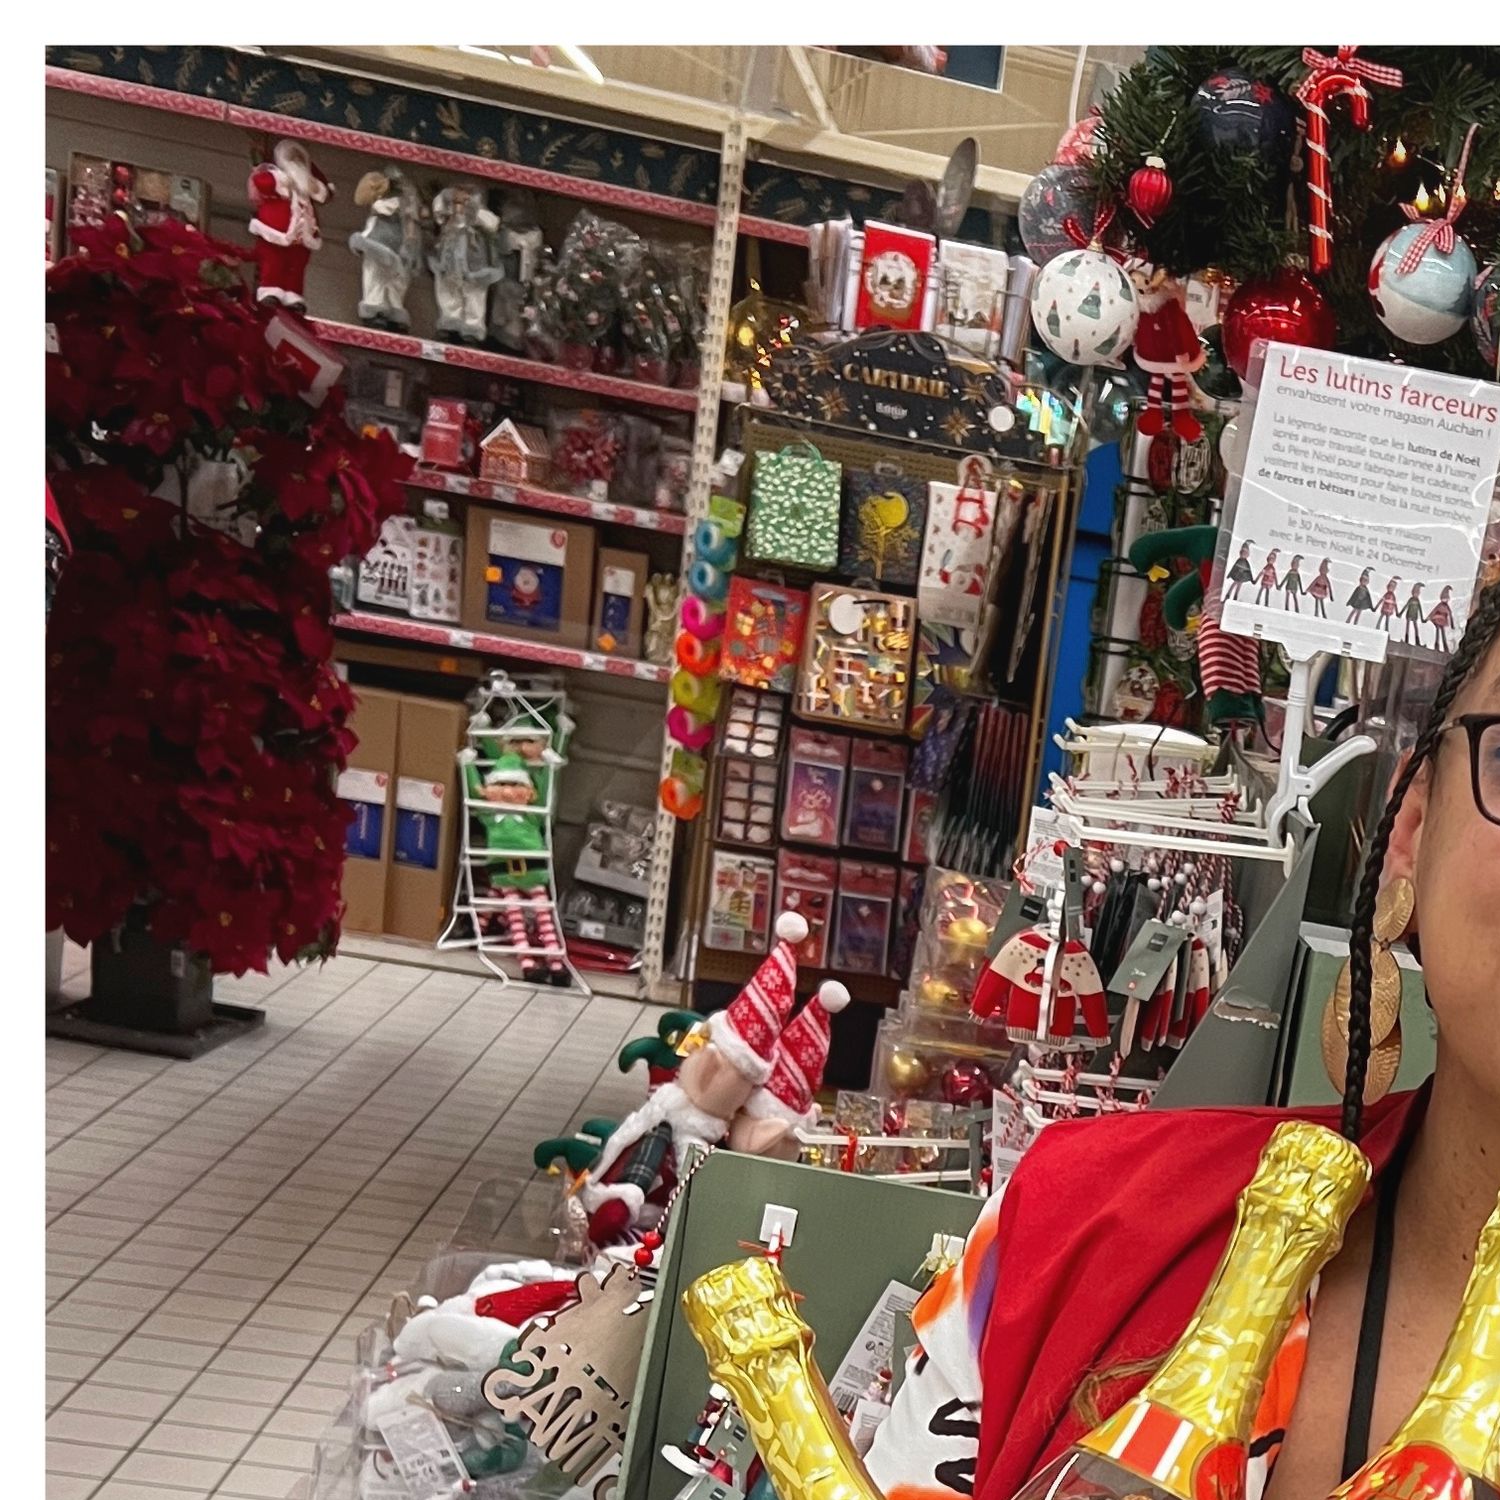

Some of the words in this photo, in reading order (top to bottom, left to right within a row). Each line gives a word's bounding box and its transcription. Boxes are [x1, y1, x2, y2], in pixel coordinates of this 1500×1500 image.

[1280, 355, 1319, 384] Les
[1326, 365, 1393, 400] lutins
[1400, 384, 1498, 423] farceurs
[1277, 385, 1346, 409] envahissent
[1350, 401, 1380, 416] votre
[1384, 408, 1434, 427] magasin
[1437, 418, 1484, 438] Auchan
[1273, 412, 1285, 424] La
[1329, 426, 1367, 441] raconte
[1369, 434, 1389, 447] que
[1391, 437, 1405, 449] les
[1408, 441, 1437, 458] lutins
[1440, 450, 1453, 461] de
[1456, 453, 1480, 468] Noël
[1338, 458, 1361, 470] pour
[1258, 467, 1271, 479] de
[1273, 470, 1304, 486] farces
[1306, 479, 1317, 489] et
[1319, 479, 1355, 497] bêtises
[1299, 518, 1312, 531] 30
[1313, 522, 1367, 544] Novembre
[1366, 549, 1379, 561] 24
